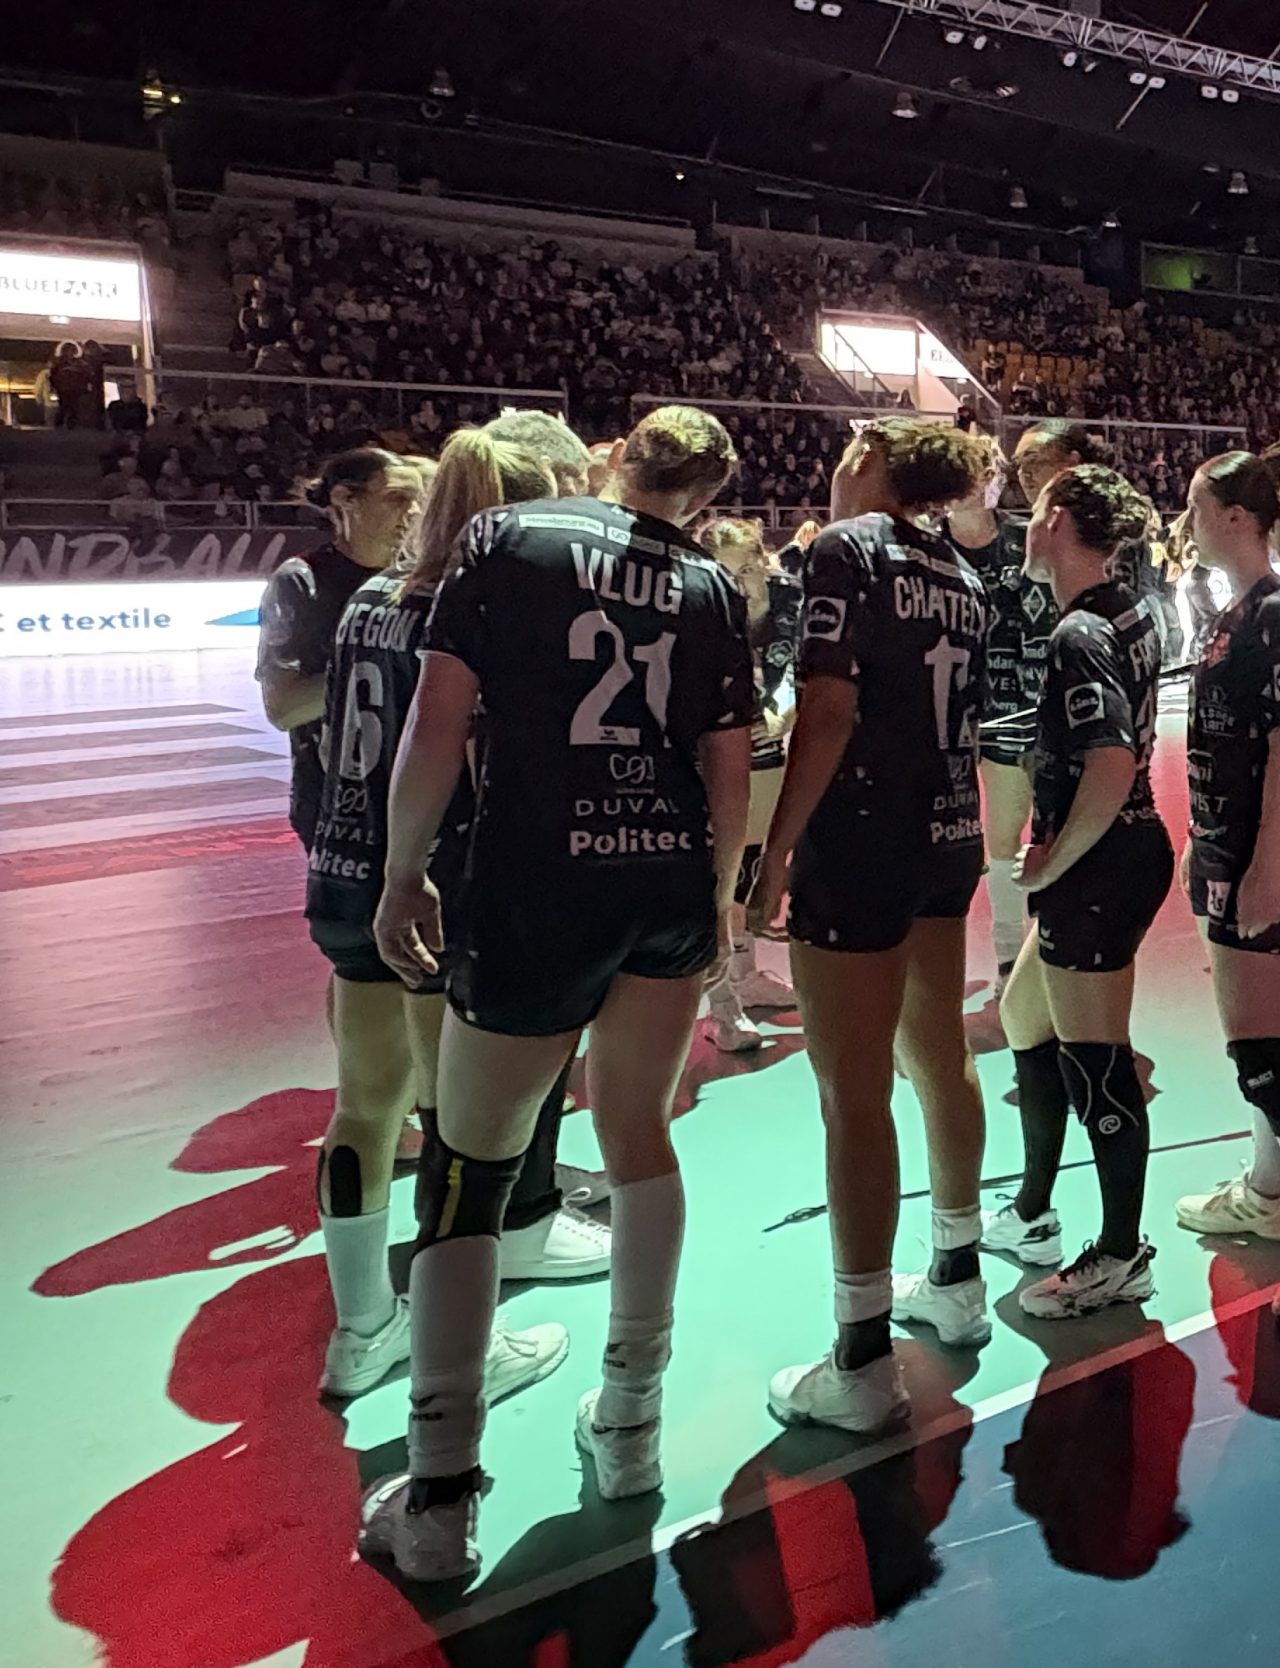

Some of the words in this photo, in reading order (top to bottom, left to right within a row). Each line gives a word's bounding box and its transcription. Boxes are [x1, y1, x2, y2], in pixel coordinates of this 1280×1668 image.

[570, 541, 684, 615] VLUG
[17, 613, 51, 632] et
[61, 607, 171, 632] textile
[568, 609, 678, 749] 21
[340, 660, 384, 781] 6
[569, 826, 692, 857] Politec
